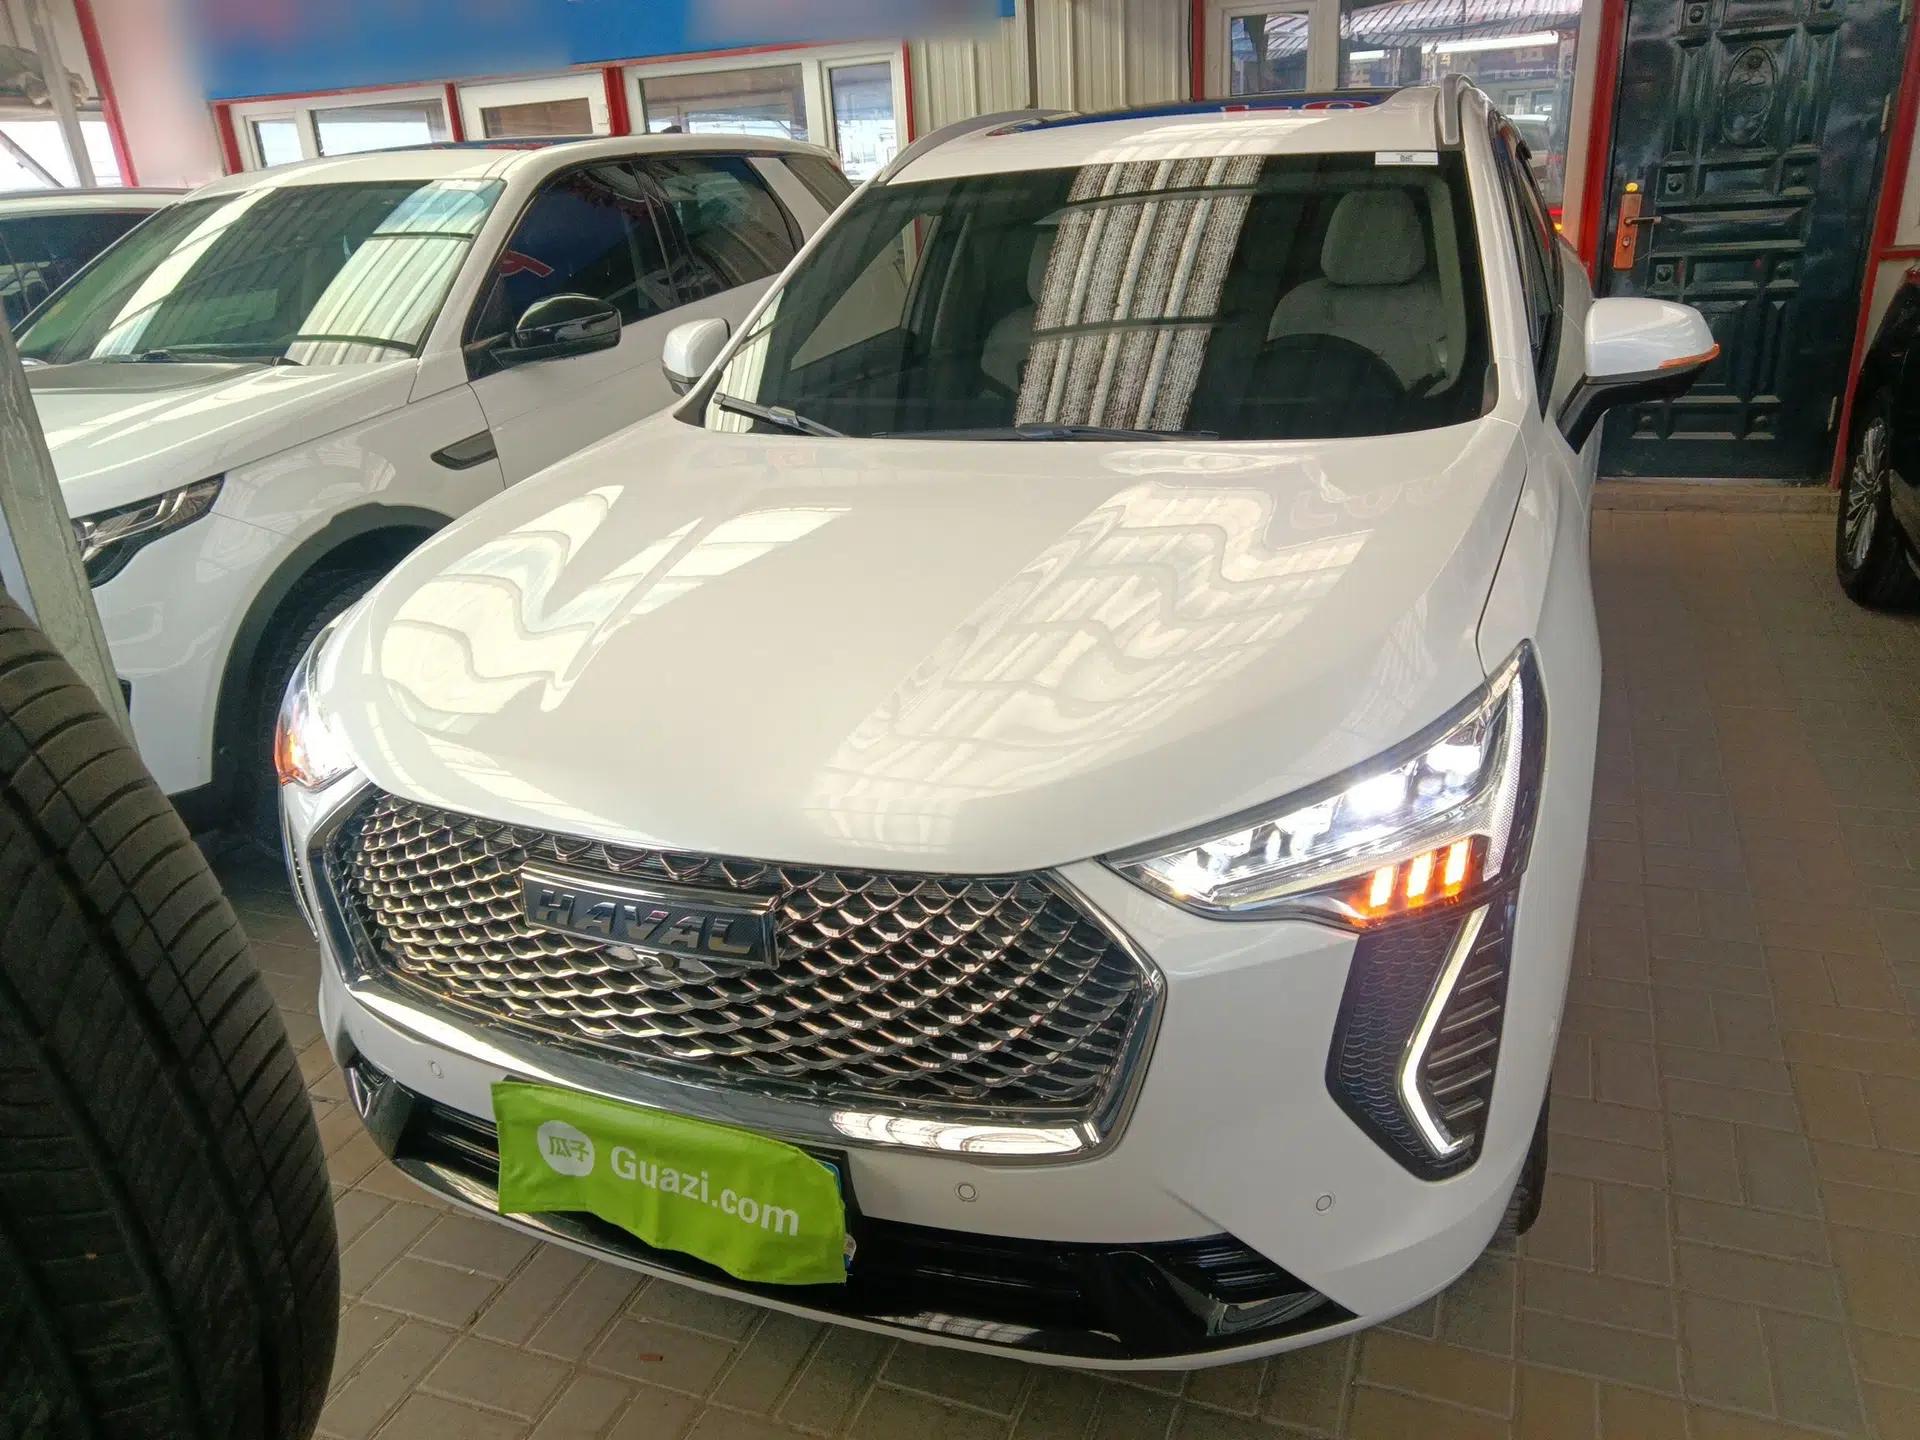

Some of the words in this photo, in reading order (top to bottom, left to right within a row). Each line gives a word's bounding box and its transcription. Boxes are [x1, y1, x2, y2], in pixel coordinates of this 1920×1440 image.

[537, 889, 751, 954] HAVAL
[549, 1135, 589, 1162] 瓜子
[610, 1146, 799, 1236] Guazi.com
